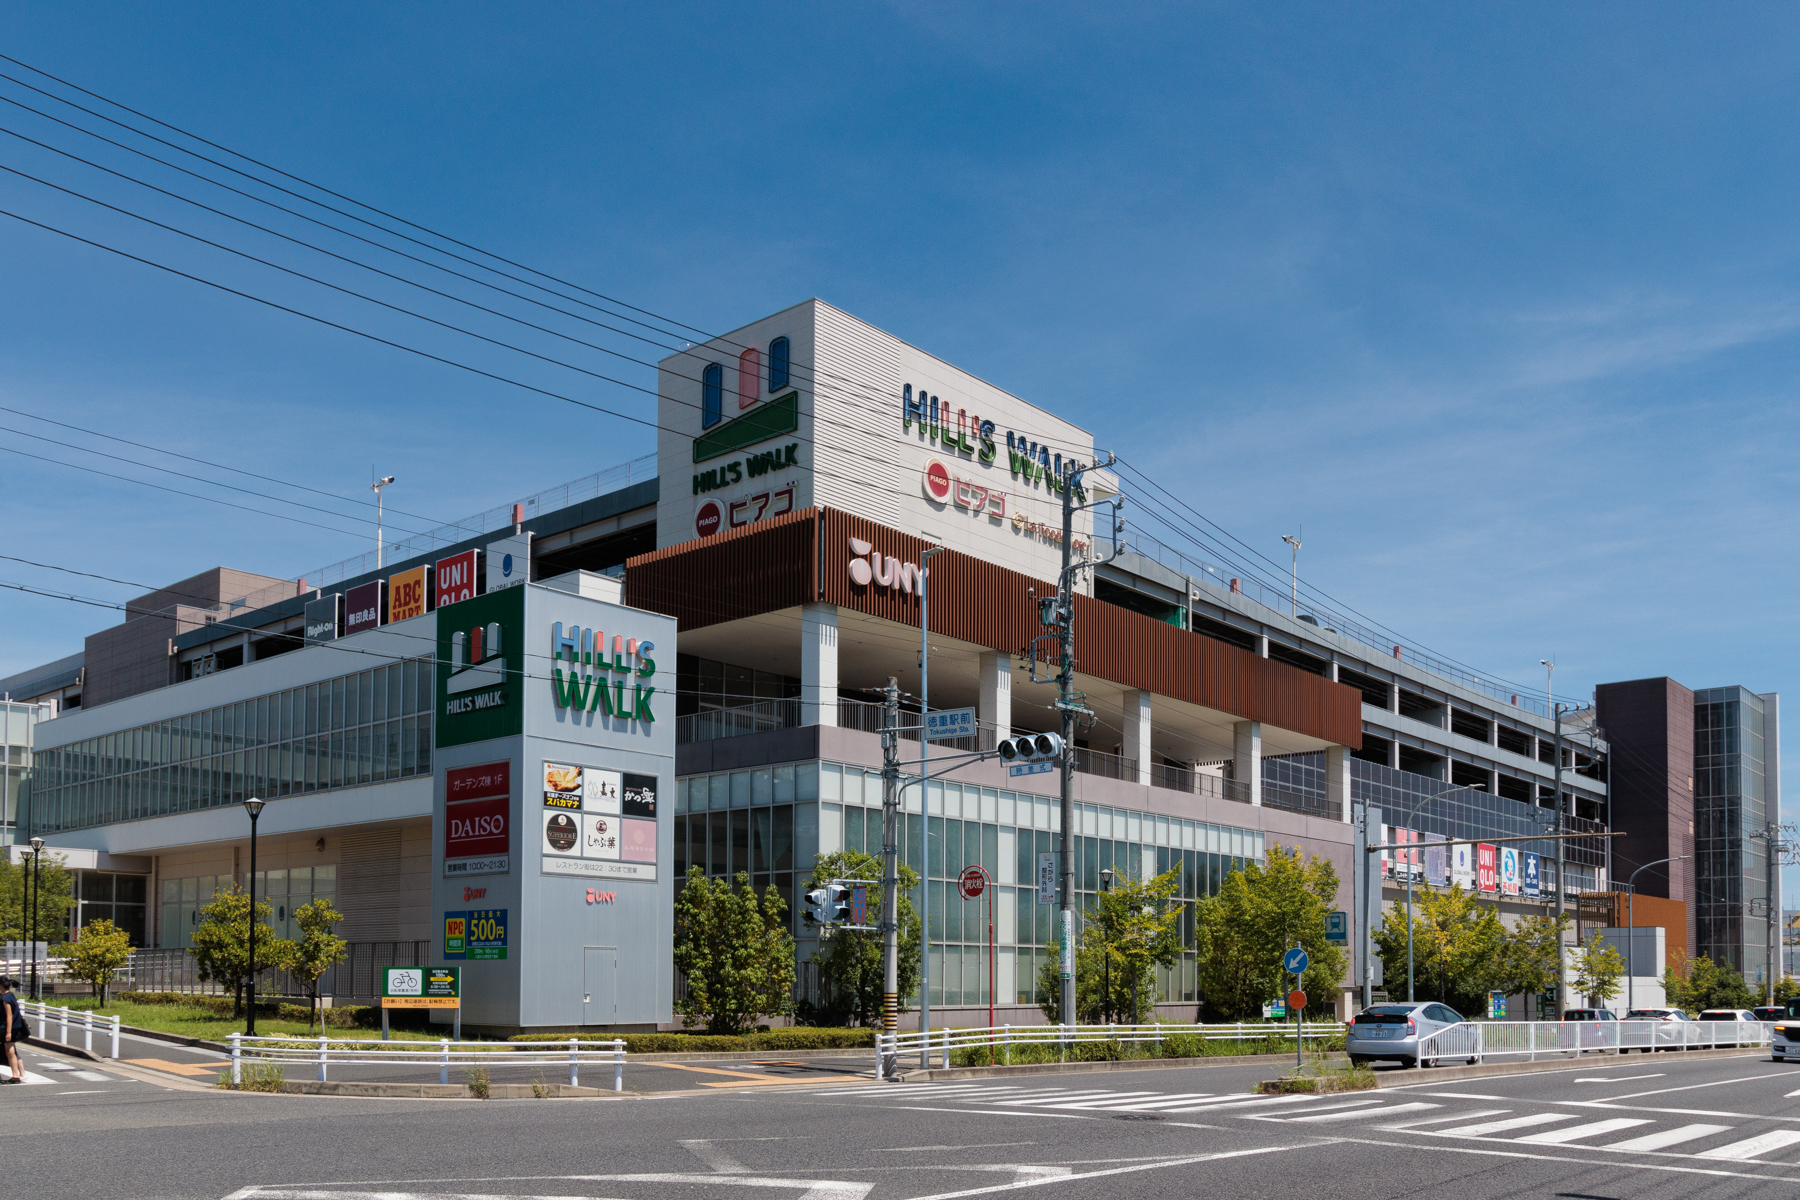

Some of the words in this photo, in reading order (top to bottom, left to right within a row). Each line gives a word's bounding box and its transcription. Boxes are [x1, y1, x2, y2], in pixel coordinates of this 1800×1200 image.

[902, 382, 997, 463] HILL'S
[692, 461, 743, 496] HILL'S
[745, 442, 799, 479] WALK
[929, 474, 947, 487] PIAGO
[729, 480, 798, 529] ピアゴ
[954, 476, 1008, 520] ピアゴ
[698, 515, 718, 527] PIAGO
[440, 561, 468, 590] UNI
[872, 551, 930, 597] UNY
[392, 578, 421, 610] ABC
[348, 607, 376, 627] 無印良品
[552, 620, 656, 678] HILL'S
[446, 696, 473, 715] HILL'S
[474, 690, 502, 710] WALK
[552, 667, 656, 723] WALK
[927, 712, 971, 728] 徳重駅前
[929, 727, 958, 737] Tokushige
[1015, 763, 1047, 775] 時差式
[453, 776, 491, 791] ガーデンズ棟
[493, 773, 503, 785] 1F
[450, 814, 504, 838] DAISO
[587, 834, 616, 850] しゃぶ葉
[447, 862, 467, 873] 営業時間
[1479, 849, 1493, 867] UNI
[964, 877, 984, 890] 消火栓
[1479, 868, 1494, 888] QLO
[469, 888, 486, 900] UNY
[594, 891, 617, 904] UNY
[447, 920, 464, 936] NPC
[470, 918, 504, 941] 500円
